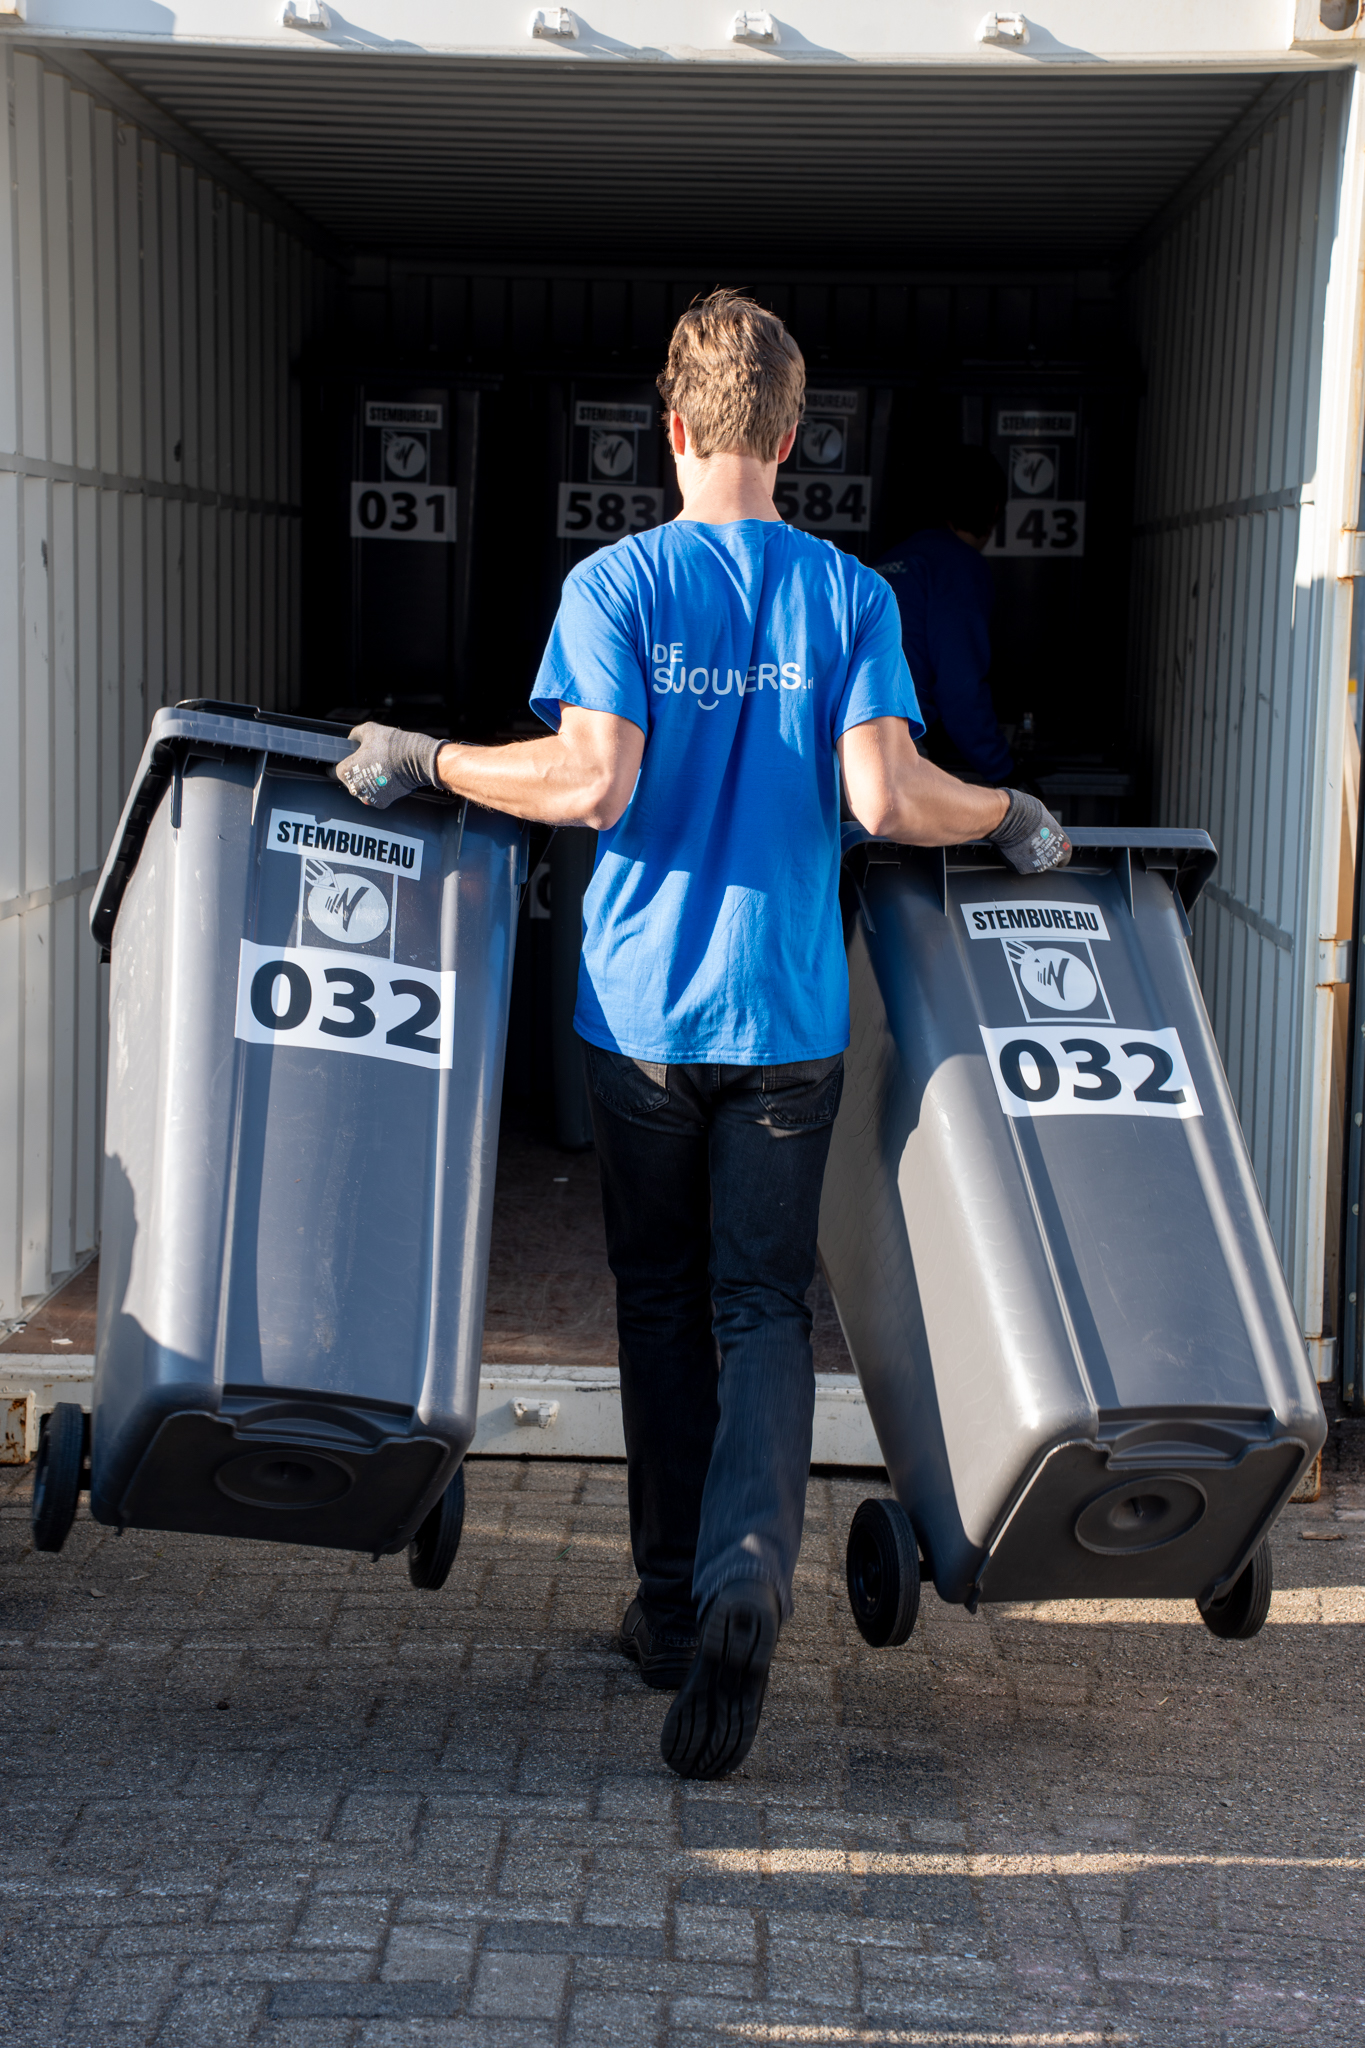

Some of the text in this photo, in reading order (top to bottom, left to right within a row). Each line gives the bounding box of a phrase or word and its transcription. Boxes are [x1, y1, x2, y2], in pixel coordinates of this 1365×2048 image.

[369, 407, 438, 424] STEMBUREAU
[579, 407, 648, 424] STEMBUREAU
[805, 392, 857, 410] MBUREAU
[1002, 415, 1072, 431] STEMBUREAU
[360, 490, 445, 533] 031
[566, 491, 658, 534] 583
[774, 481, 866, 523] 584
[653, 642, 684, 664] DE
[276, 820, 416, 869] STEMBUREAU
[972, 909, 1099, 931] STEMBUREAU
[250, 960, 442, 1055] 032
[999, 1038, 1187, 1105] 032
